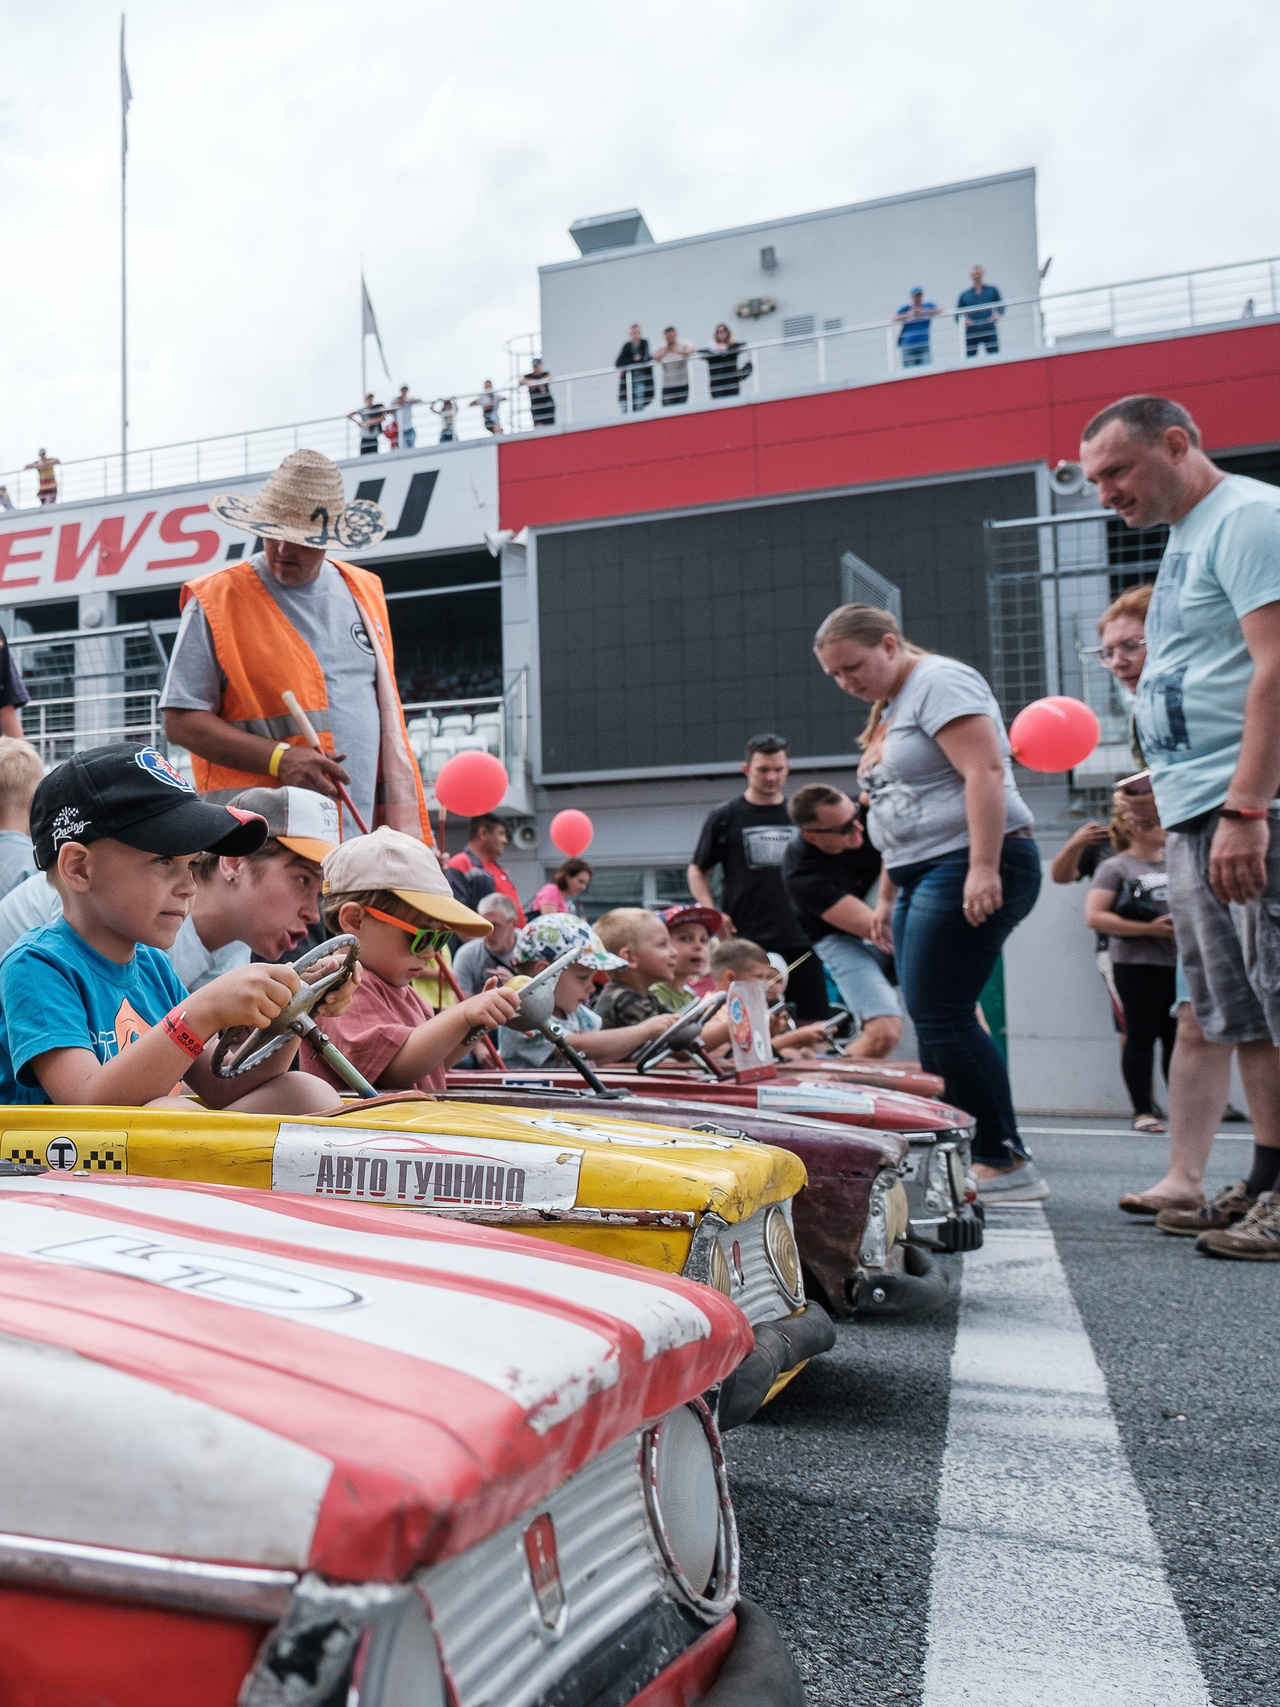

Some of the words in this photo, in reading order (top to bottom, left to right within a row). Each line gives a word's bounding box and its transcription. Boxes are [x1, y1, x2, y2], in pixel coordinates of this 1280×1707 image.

[51, 820, 92, 851] Racing
[315, 1154, 388, 1197] АВТО
[395, 1159, 526, 1207] ТУШИНО
